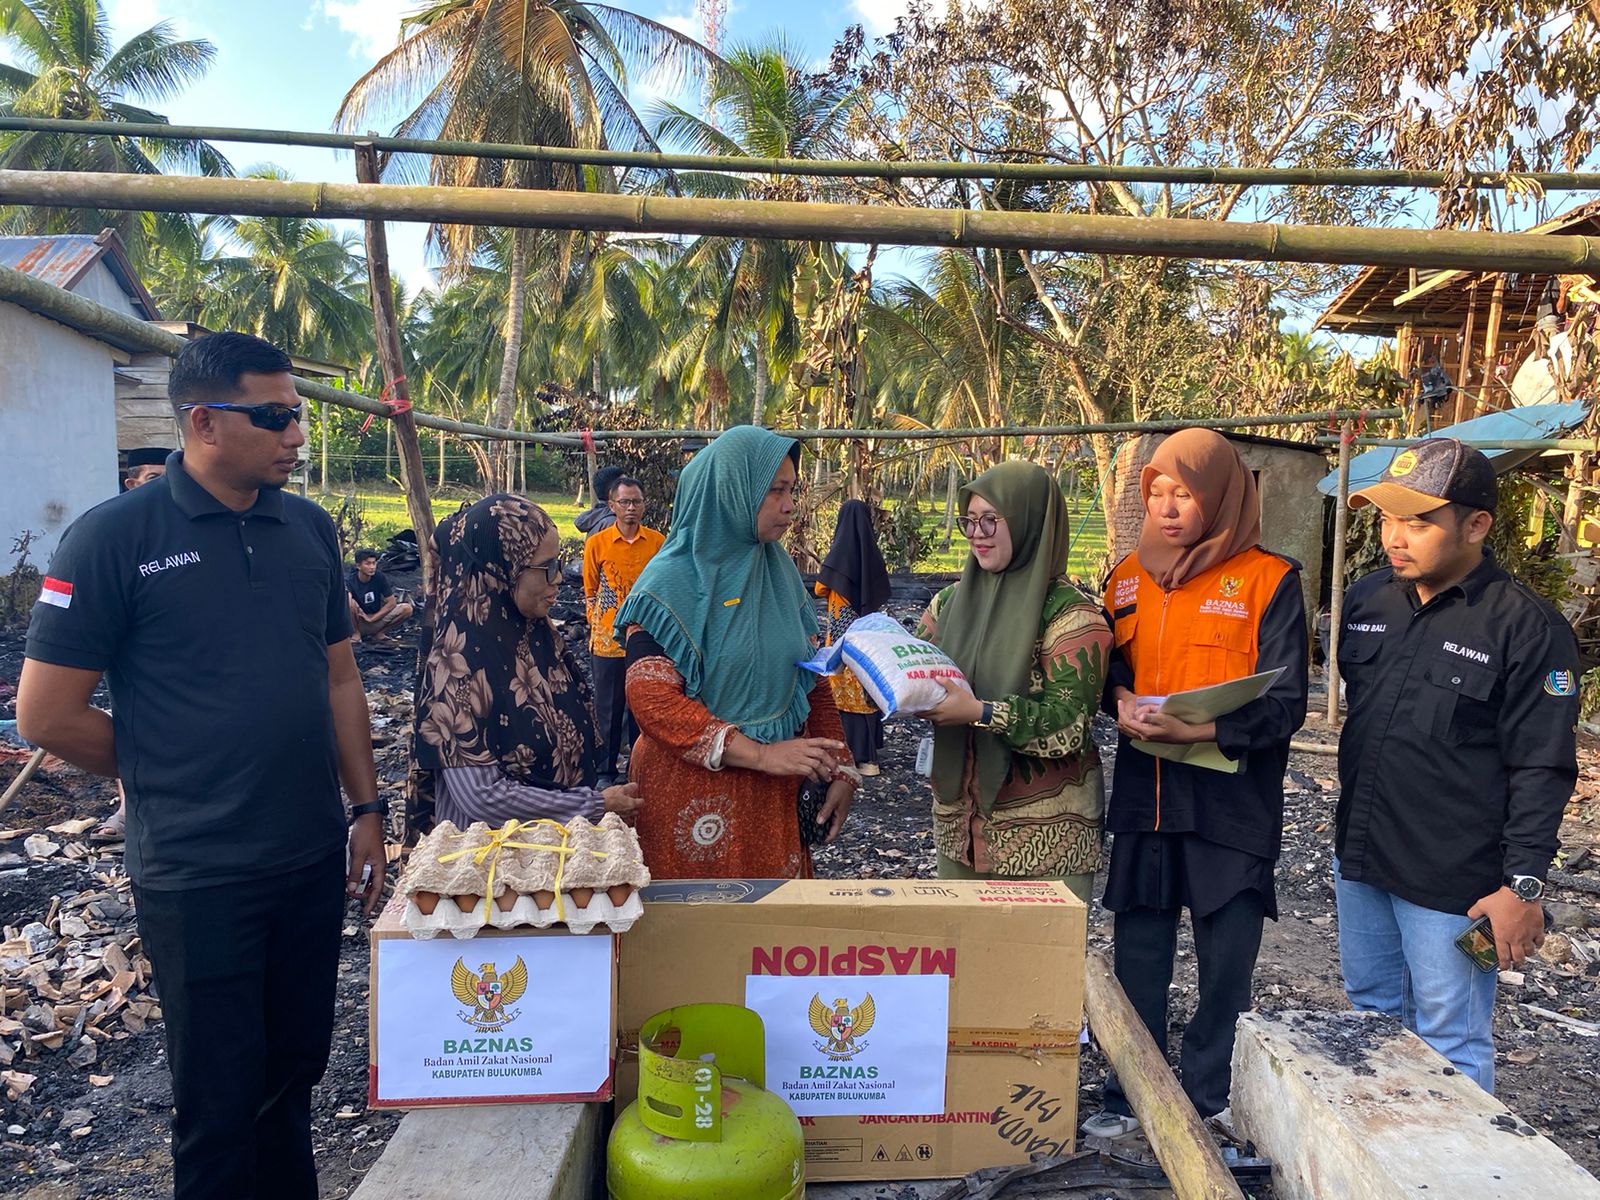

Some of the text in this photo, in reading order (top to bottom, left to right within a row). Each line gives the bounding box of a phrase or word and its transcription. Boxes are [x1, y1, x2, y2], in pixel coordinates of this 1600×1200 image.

[138, 550, 201, 577] RELAWAN
[1117, 576, 1140, 588] ZNAS
[1205, 599, 1245, 610] BAZNAS
[1370, 624, 1387, 632] BALI
[1442, 641, 1490, 664] RELAWAN
[914, 887, 960, 899] Slim
[979, 896, 1067, 904] MASPION
[751, 945, 957, 978] MASPION
[443, 1037, 533, 1054] BAZNAS
[972, 1040, 1017, 1049] MASPION
[423, 1054, 553, 1067] Badan Amil Zakat Nasional
[432, 1068, 542, 1079] KABUPATEN BULUKUMBA
[799, 1066, 879, 1079] BAZNAS
[782, 1080, 896, 1090] Badan Amil Zakat Nasional
[789, 1092, 886, 1101] KABUPATEN BULUKUMBA
[858, 1112, 994, 1125] JANGAN DIBANTIN
